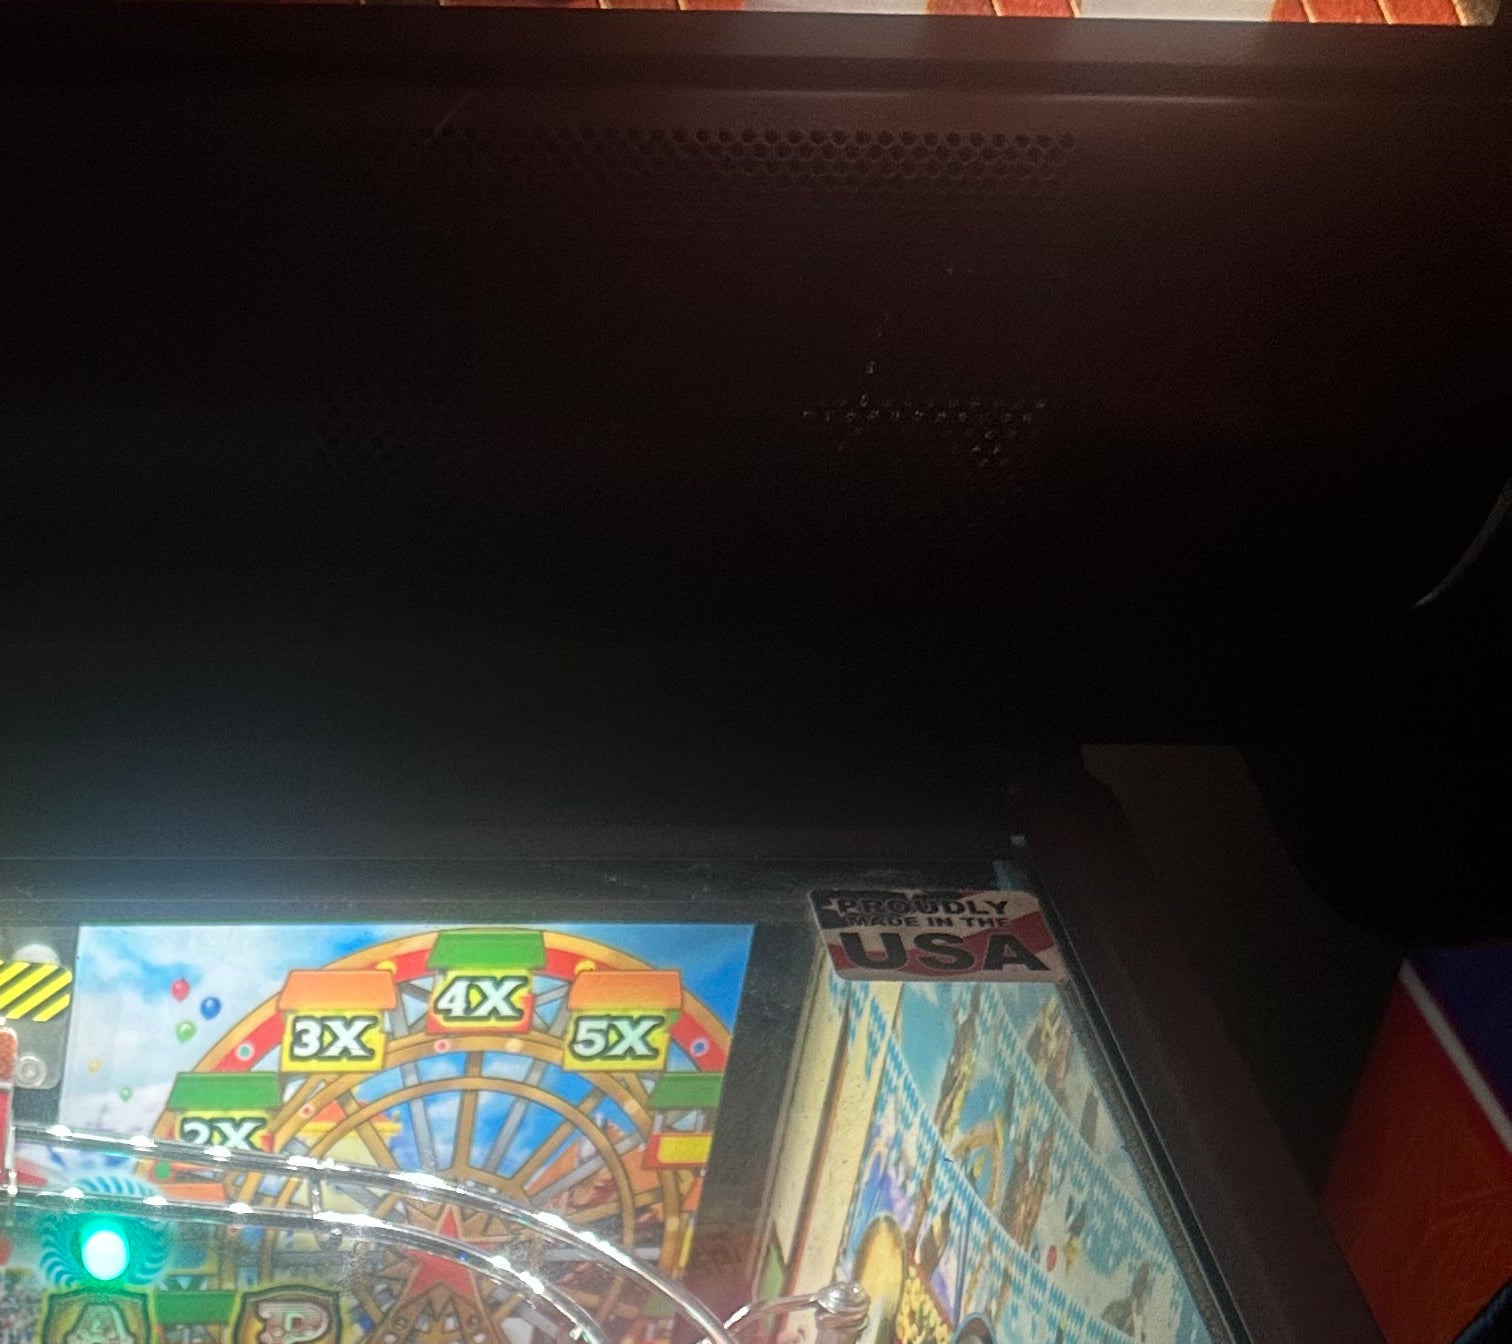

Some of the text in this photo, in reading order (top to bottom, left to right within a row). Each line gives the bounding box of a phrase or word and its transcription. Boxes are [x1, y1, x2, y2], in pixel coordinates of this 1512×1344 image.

[838, 900, 1008, 915] PROUDLY
[848, 915, 1010, 928] MADE IN THE
[839, 932, 1051, 971] USA
[434, 975, 529, 1020] 4X
[290, 1015, 378, 1061] 3X
[568, 1015, 664, 1061] 5X
[180, 1117, 267, 1150] 2X
